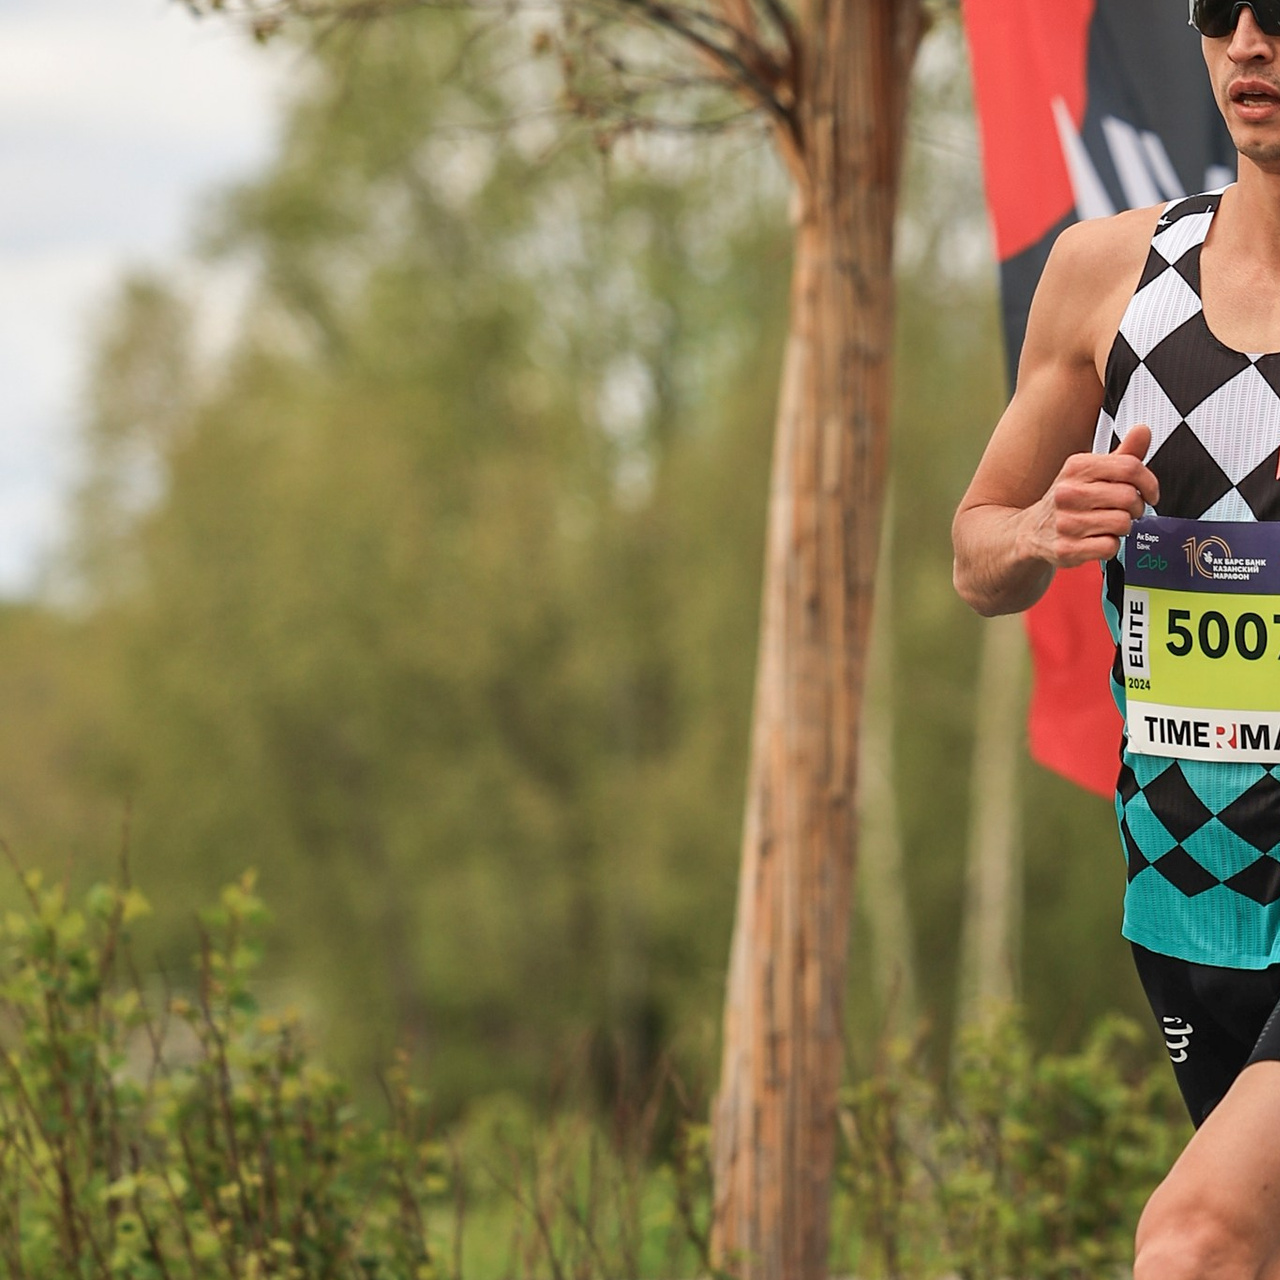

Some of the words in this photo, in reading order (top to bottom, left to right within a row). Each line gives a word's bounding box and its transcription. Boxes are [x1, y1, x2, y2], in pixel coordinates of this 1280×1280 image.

[1145, 533, 1159, 543] Барс
[1181, 535, 1232, 579] 10
[1224, 558, 1244, 566] БАРС
[1245, 559, 1267, 567] БАНК
[1212, 565, 1260, 574] КАЗАНСКИЙ
[1213, 573, 1250, 581] МАРАФОН
[1129, 600, 1144, 669] ELITE
[1128, 677, 1151, 691] 2024
